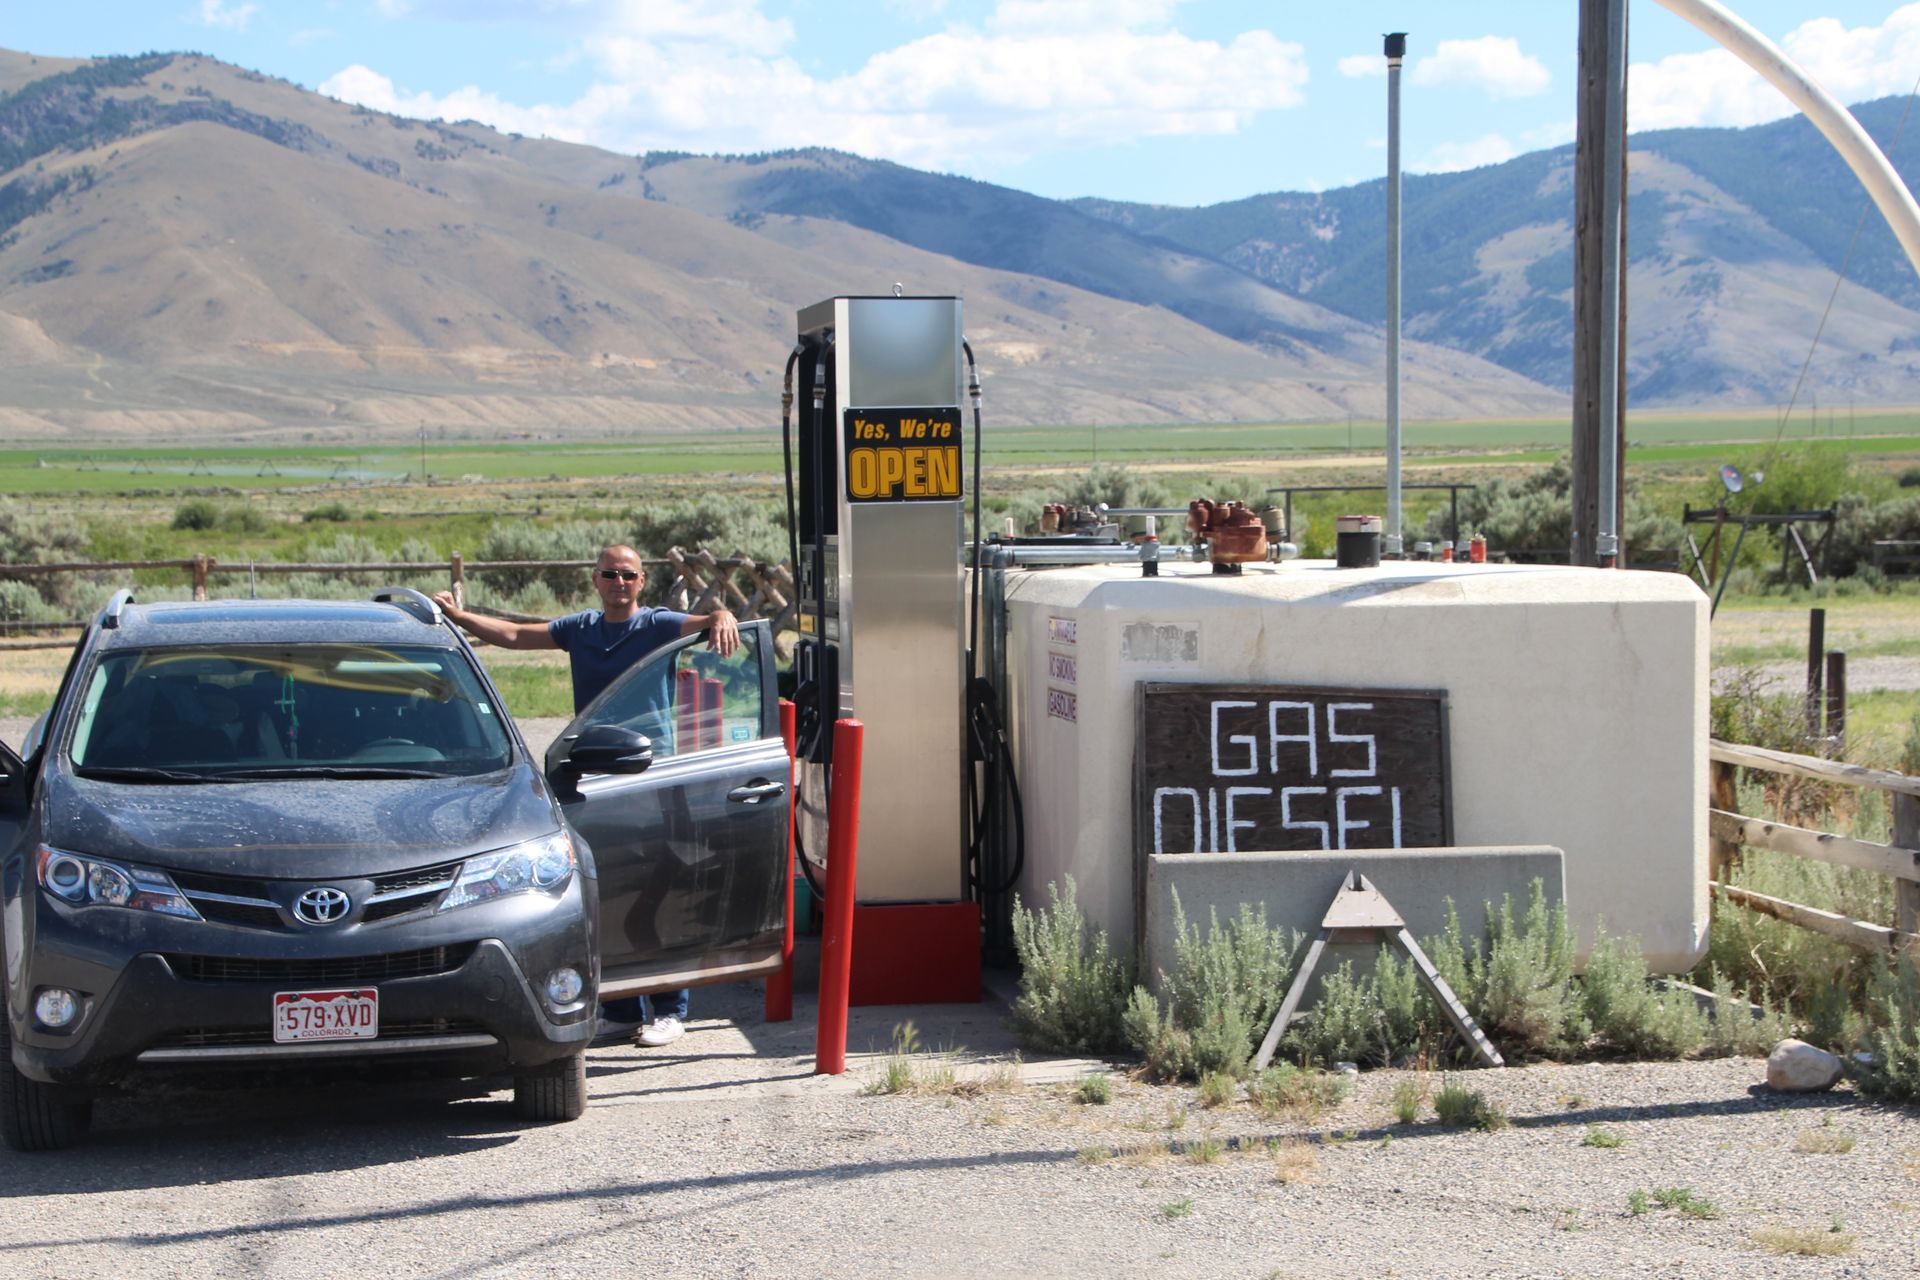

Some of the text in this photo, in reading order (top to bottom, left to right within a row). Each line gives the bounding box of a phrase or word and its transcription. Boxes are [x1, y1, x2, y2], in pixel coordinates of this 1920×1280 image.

[854, 419, 952, 440] Yes, We're
[849, 445, 960, 498] OPEN
[1048, 691, 1077, 720] GASOLINE
[1211, 700, 1377, 778] GAS
[301, 1028, 352, 1038] COLORADO
